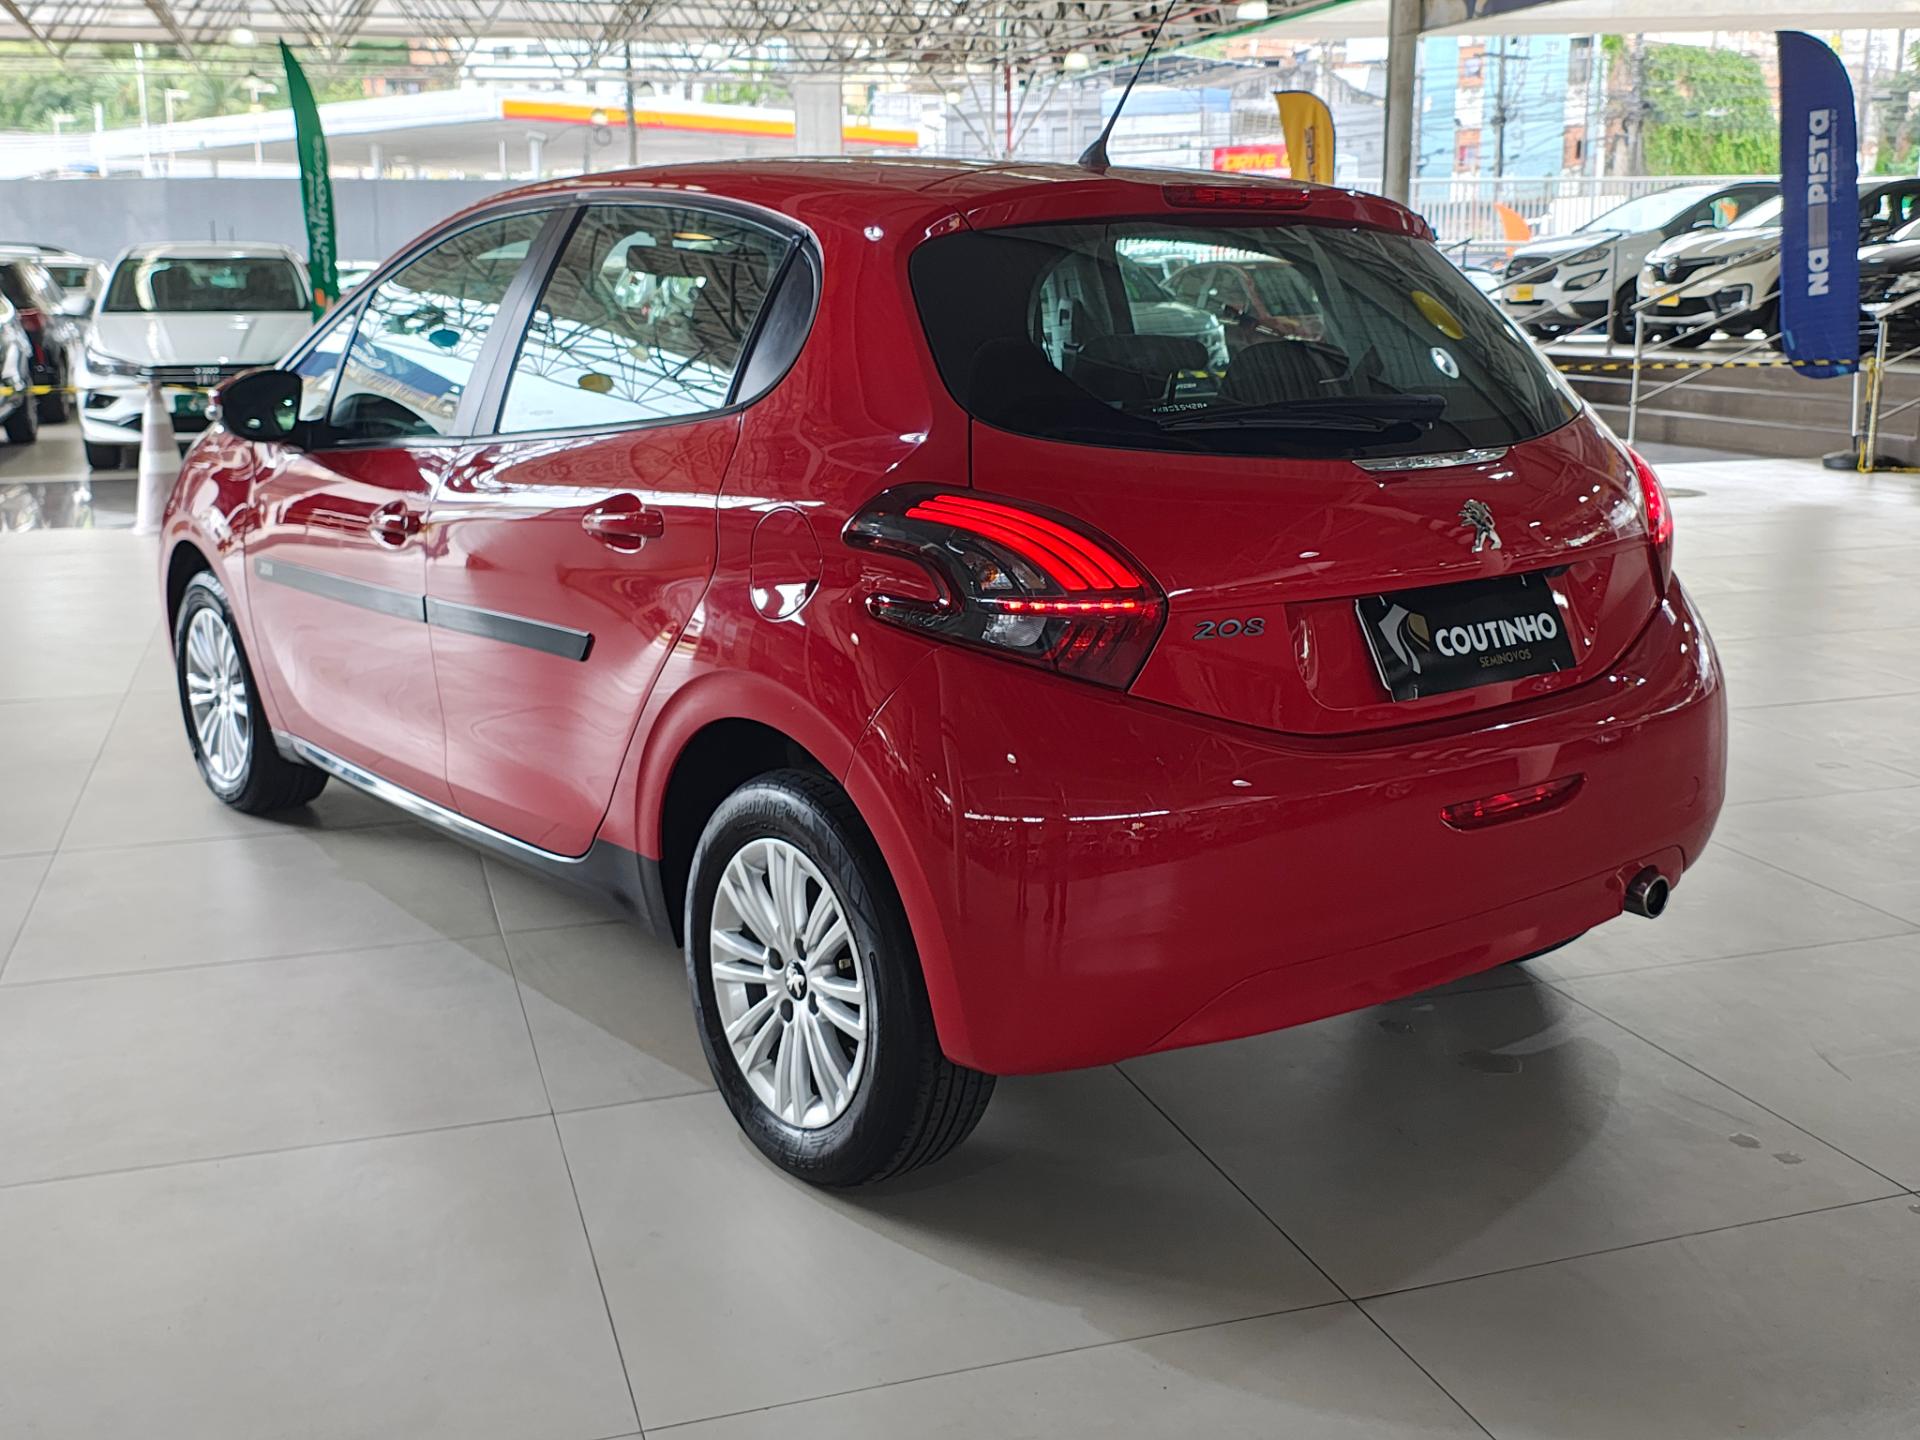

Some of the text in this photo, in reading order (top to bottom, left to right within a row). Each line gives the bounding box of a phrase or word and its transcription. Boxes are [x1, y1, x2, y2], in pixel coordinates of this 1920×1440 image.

[1223, 152, 1276, 169] DRIVE
[1192, 618, 1266, 640] 208
[1435, 612, 1557, 657] COUTINHO
[1479, 649, 1532, 668] SEMINOVOS
